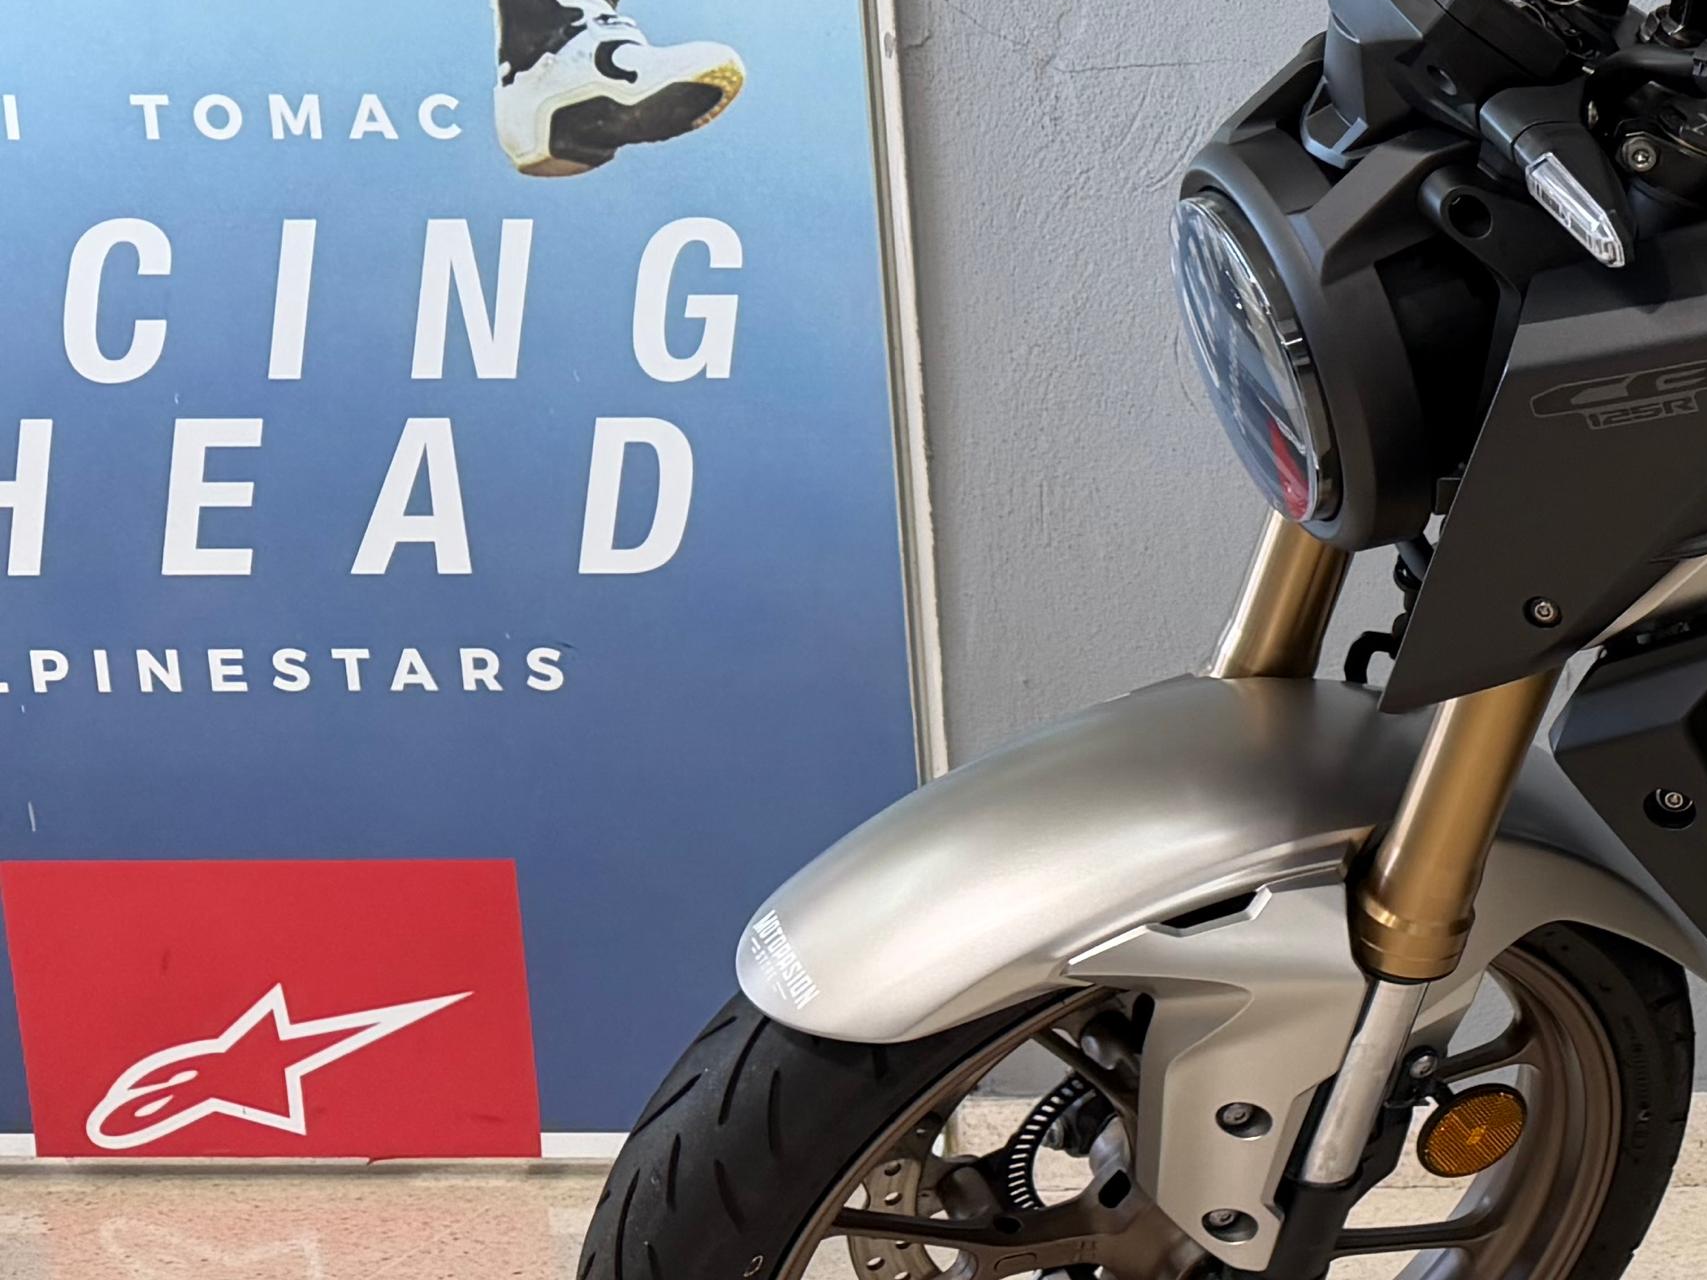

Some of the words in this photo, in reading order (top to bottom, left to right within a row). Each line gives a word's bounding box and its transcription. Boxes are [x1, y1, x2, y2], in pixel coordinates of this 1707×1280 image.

[129, 93, 463, 141] TOMAC
[1585, 395, 1700, 430] 125R
[0, 647, 567, 693] PINESTARS
[752, 909, 821, 1011] MOTOPASION
